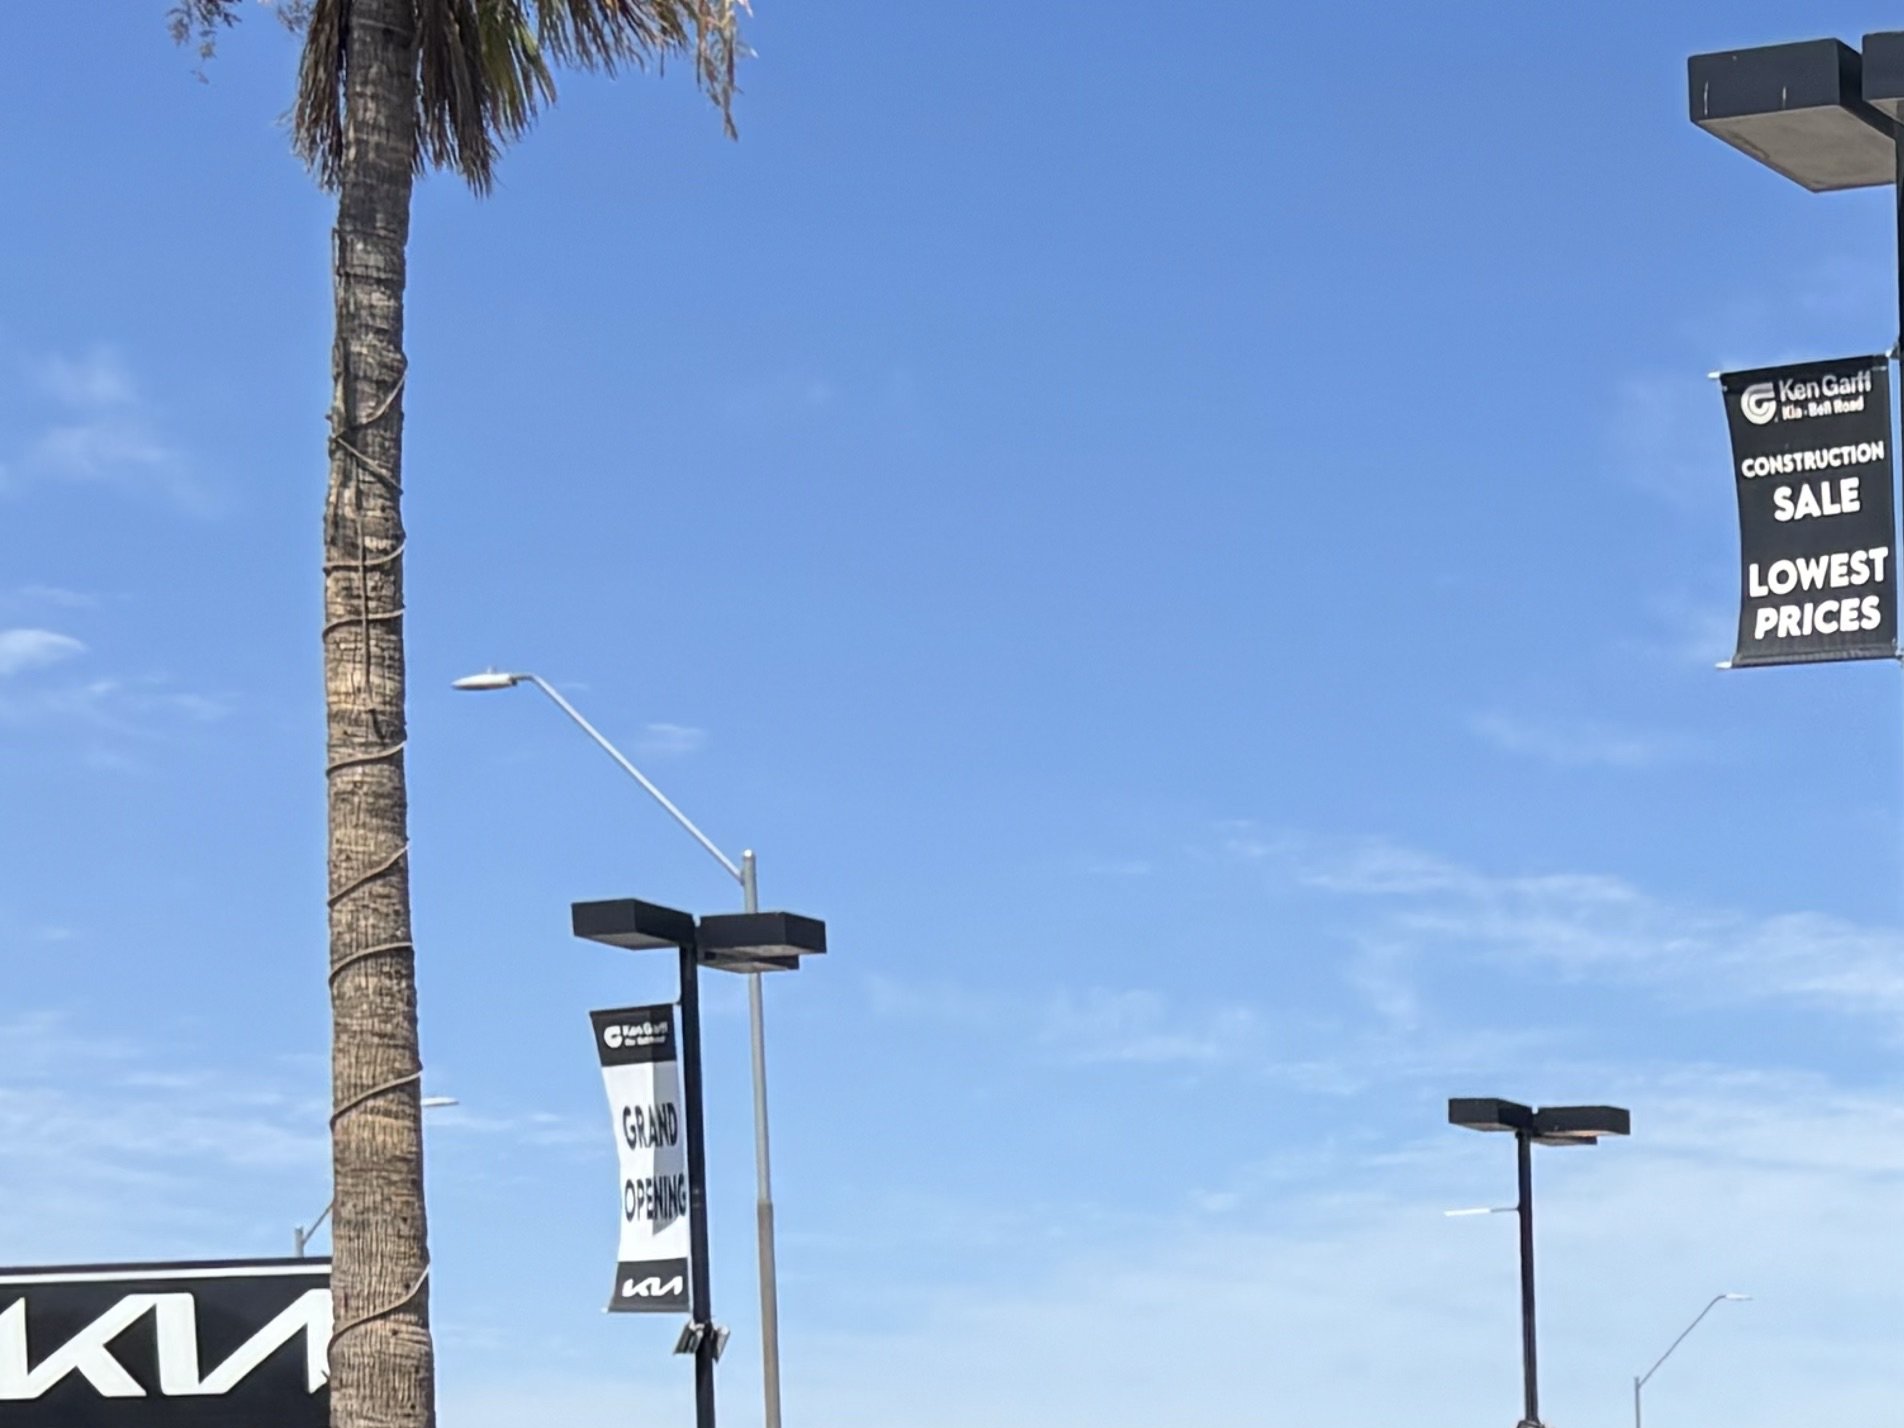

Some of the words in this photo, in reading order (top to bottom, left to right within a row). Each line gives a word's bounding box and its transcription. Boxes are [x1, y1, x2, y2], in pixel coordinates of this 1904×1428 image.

[1779, 378, 1820, 402] Ken
[1822, 369, 1872, 397] Garff
[1741, 440, 1885, 478] CONSTRUCTION
[1773, 476, 1861, 522] SALE
[1748, 547, 1889, 598] LOWEST
[1754, 595, 1882, 640] PRICES
[622, 1101, 678, 1150] GRAND
[624, 1173, 687, 1223] OPENING
